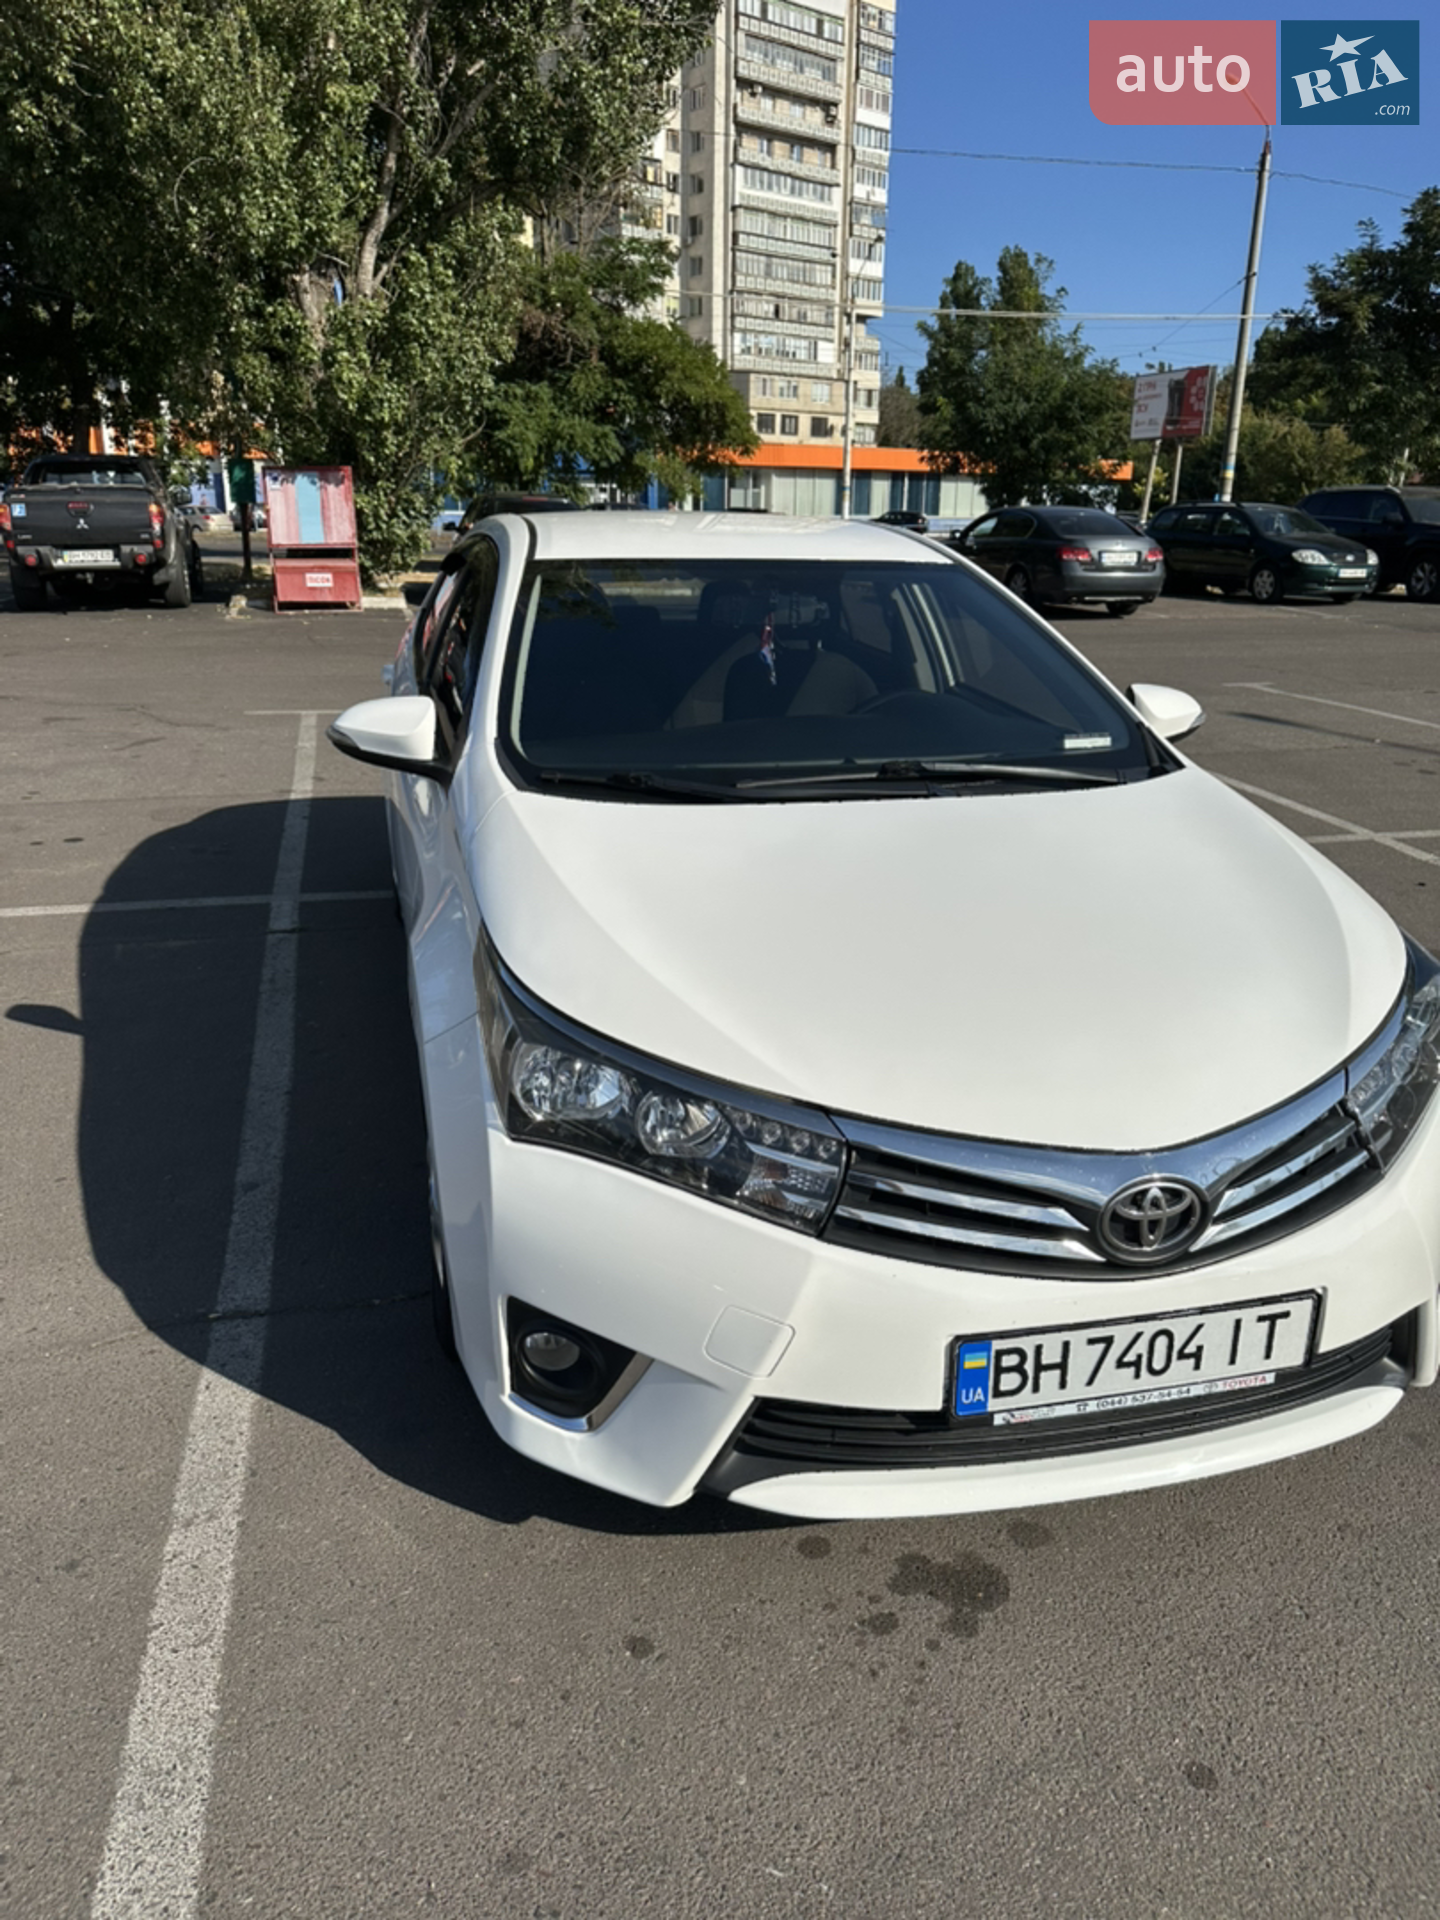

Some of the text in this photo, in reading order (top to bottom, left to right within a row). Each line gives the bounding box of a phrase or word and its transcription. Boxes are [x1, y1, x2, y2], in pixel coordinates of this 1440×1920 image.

[992, 1310, 1291, 1399] BH 7404 IT
[1222, 1376, 1267, 1390] TOYOTA
[961, 1388, 985, 1406] UA
